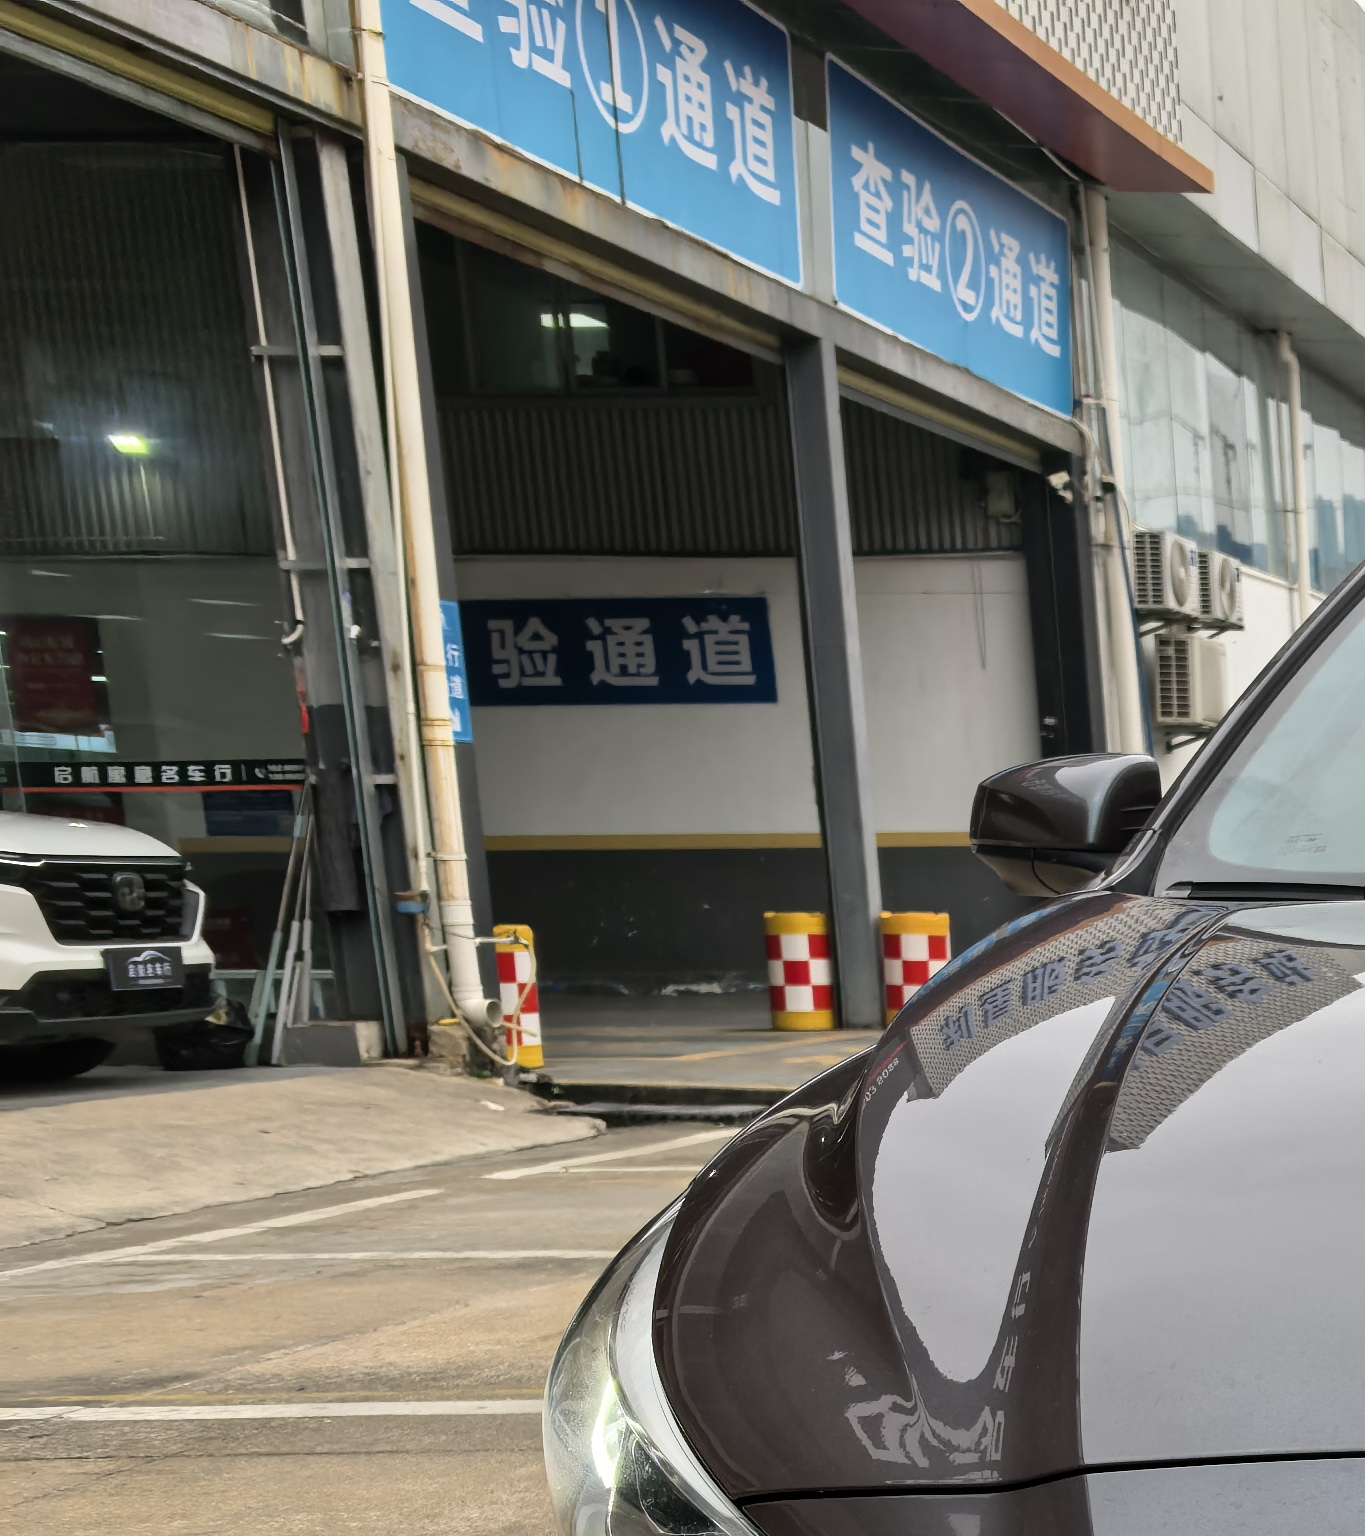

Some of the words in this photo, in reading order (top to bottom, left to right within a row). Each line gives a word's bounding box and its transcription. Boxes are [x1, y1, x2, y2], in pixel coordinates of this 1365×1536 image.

[408, 0, 780, 206] 验①通道
[487, 615, 757, 688] 验通道
